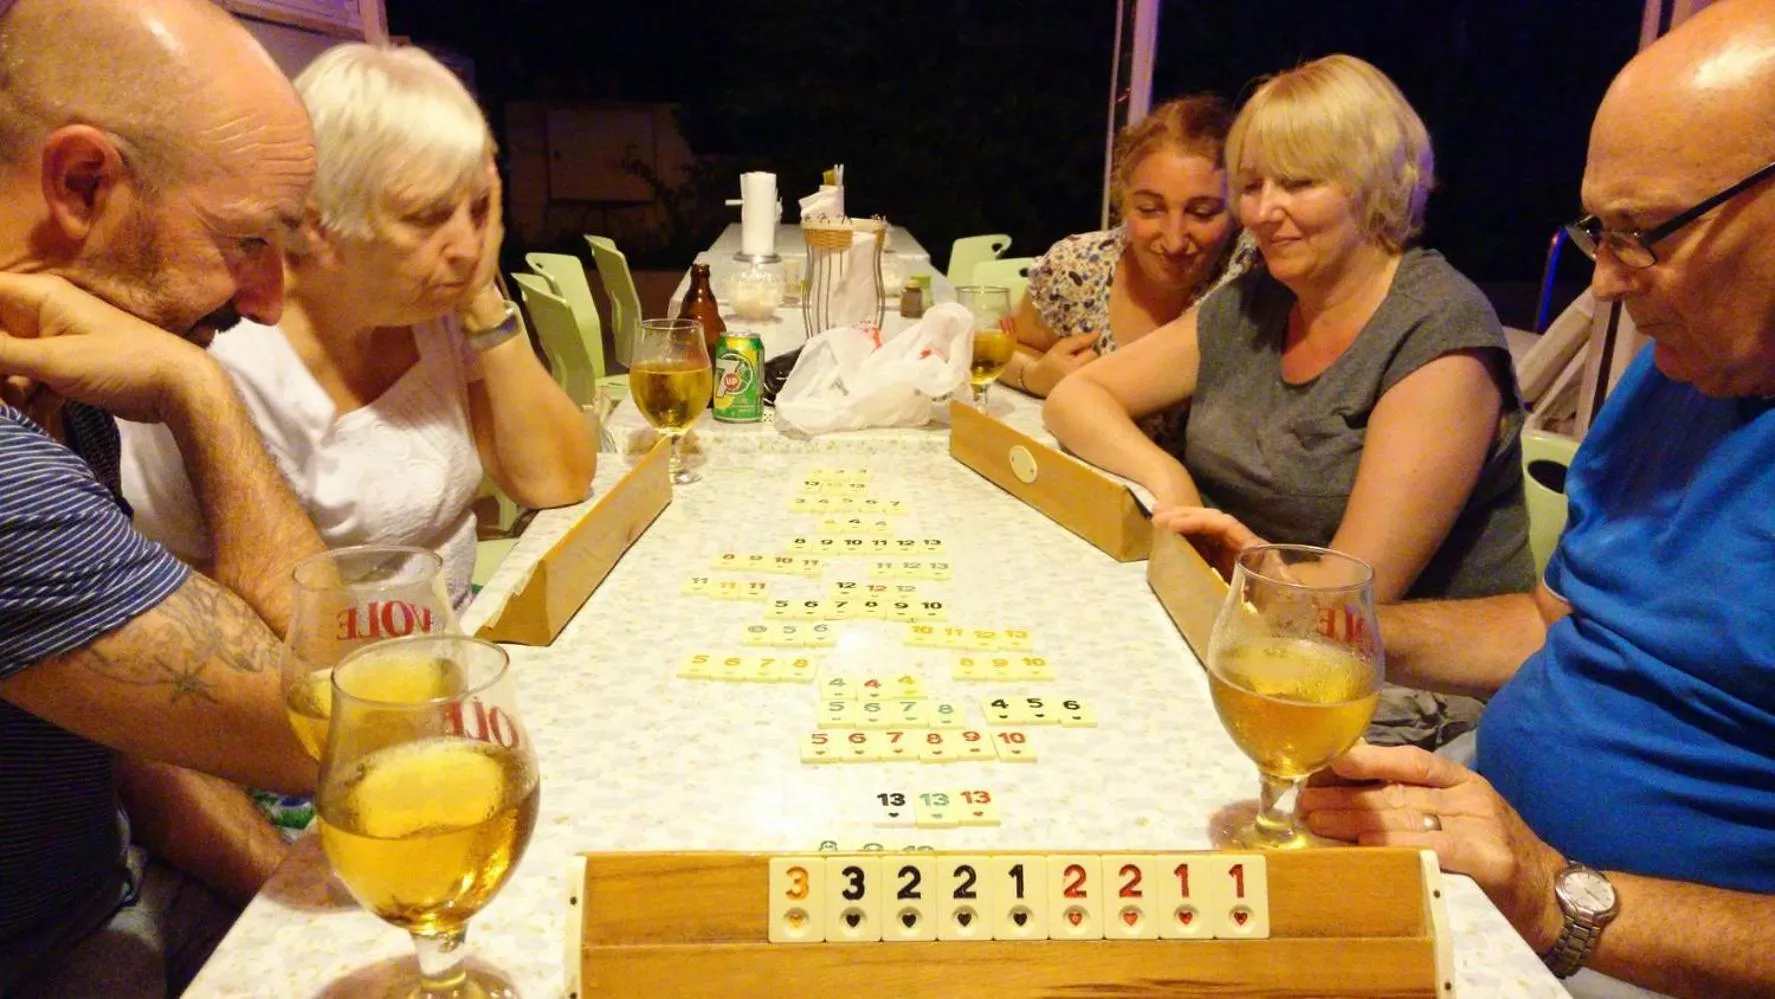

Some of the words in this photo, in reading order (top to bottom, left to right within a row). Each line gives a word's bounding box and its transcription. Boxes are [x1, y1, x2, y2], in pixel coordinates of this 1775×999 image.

[828, 678, 846, 687] 4
[864, 679, 882, 688] 4
[898, 676, 916, 685] 4
[828, 702, 845, 712] 5
[864, 702, 881, 712] 6
[900, 701, 917, 712] 7
[938, 704, 954, 714] 8
[991, 699, 1009, 709] 4
[1026, 698, 1044, 709] 5
[1062, 700, 1081, 711] 6
[811, 733, 828, 745] 5
[848, 732, 867, 744] 6
[886, 731, 904, 743] 7
[926, 733, 943, 745] 8
[962, 731, 981, 742] 9
[997, 732, 1026, 744] 10
[877, 792, 906, 806] 13
[919, 792, 950, 807] 13
[960, 790, 991, 804] 13
[785, 866, 809, 901] 3
[841, 865, 865, 900] 3
[897, 865, 922, 900] 2
[953, 864, 977, 899] 2
[1008, 864, 1025, 899] 1
[1063, 863, 1087, 898] 2
[1119, 863, 1143, 898] 2
[1173, 863, 1190, 898] 1
[1228, 863, 1245, 898] 1
